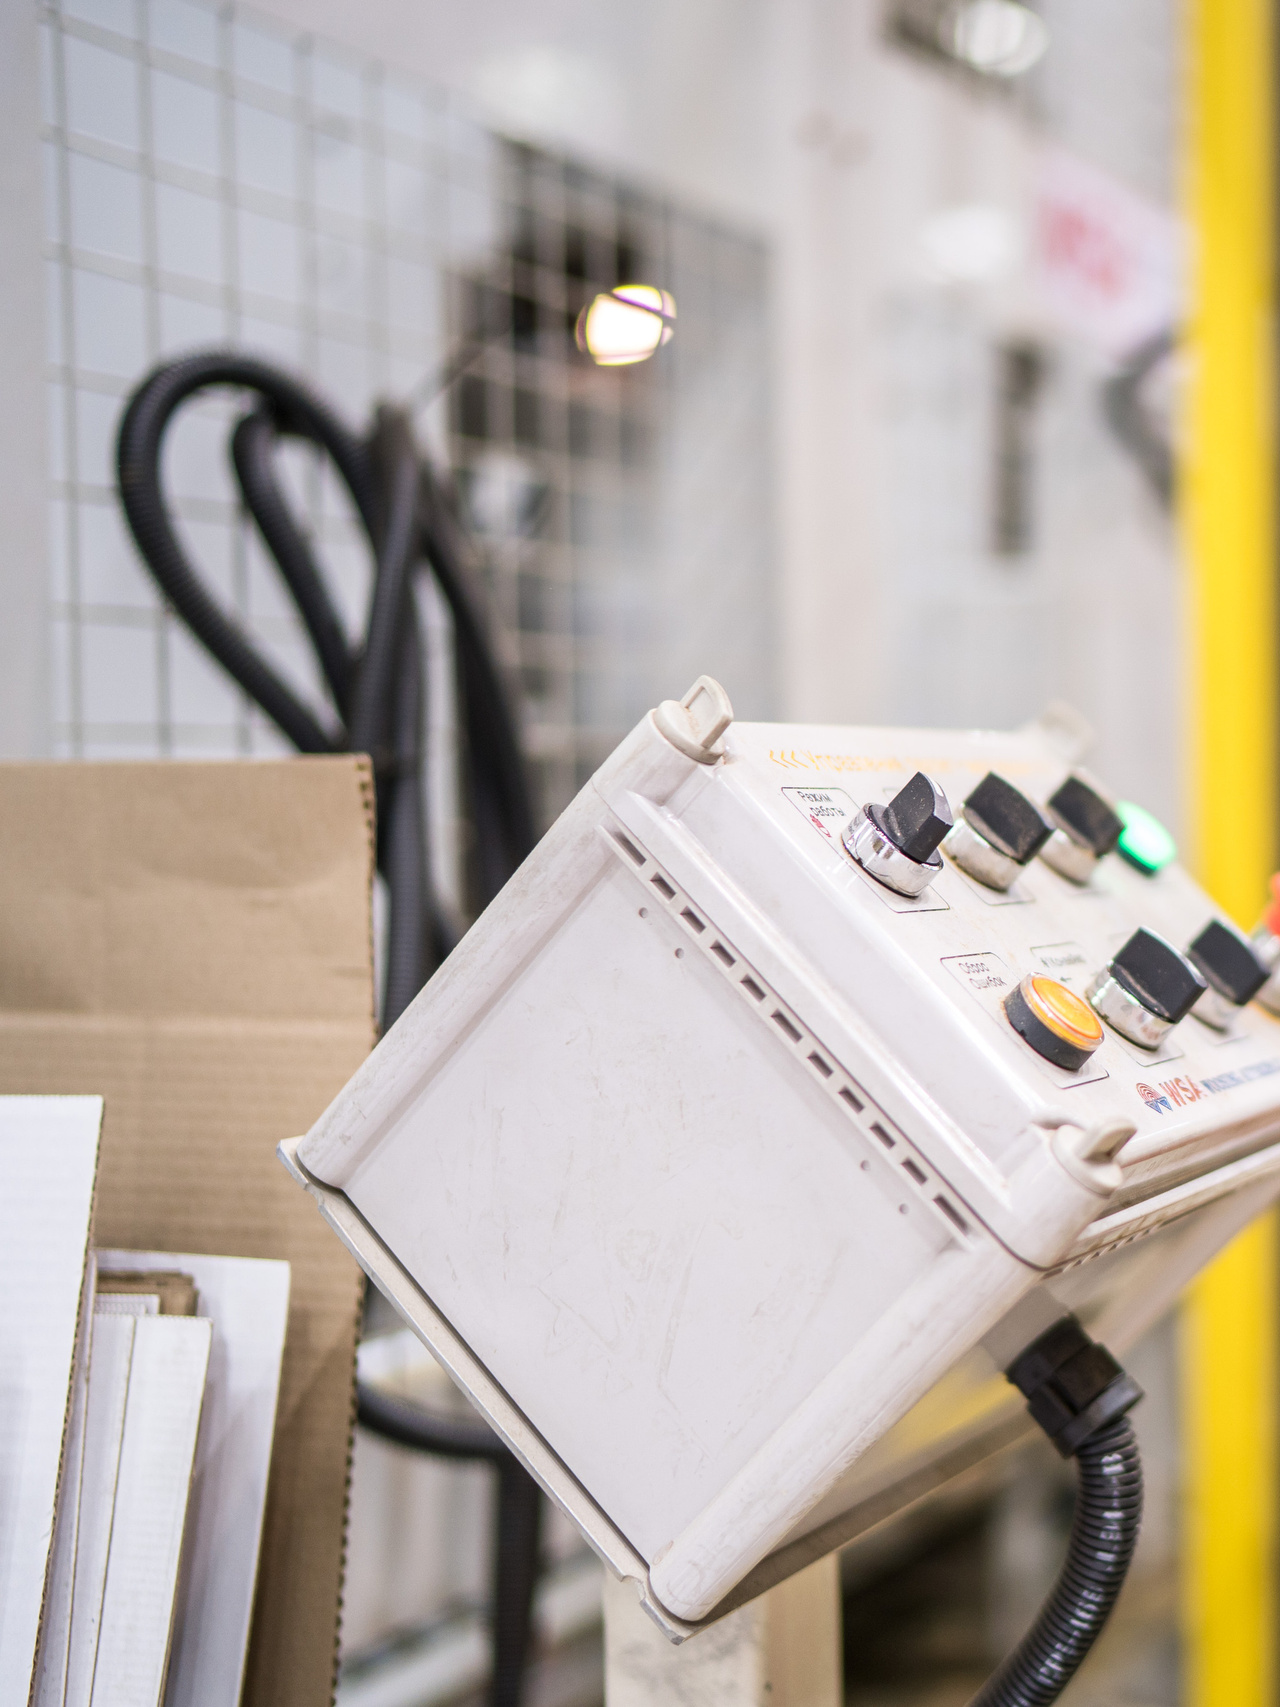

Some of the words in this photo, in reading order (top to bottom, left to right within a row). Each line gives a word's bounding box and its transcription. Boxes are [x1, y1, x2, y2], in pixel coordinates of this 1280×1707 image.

[797, 791, 833, 802] Режим
[810, 806, 845, 817] работы
[958, 962, 989, 974] Сброс
[1158, 1075, 1207, 1107] WSA
